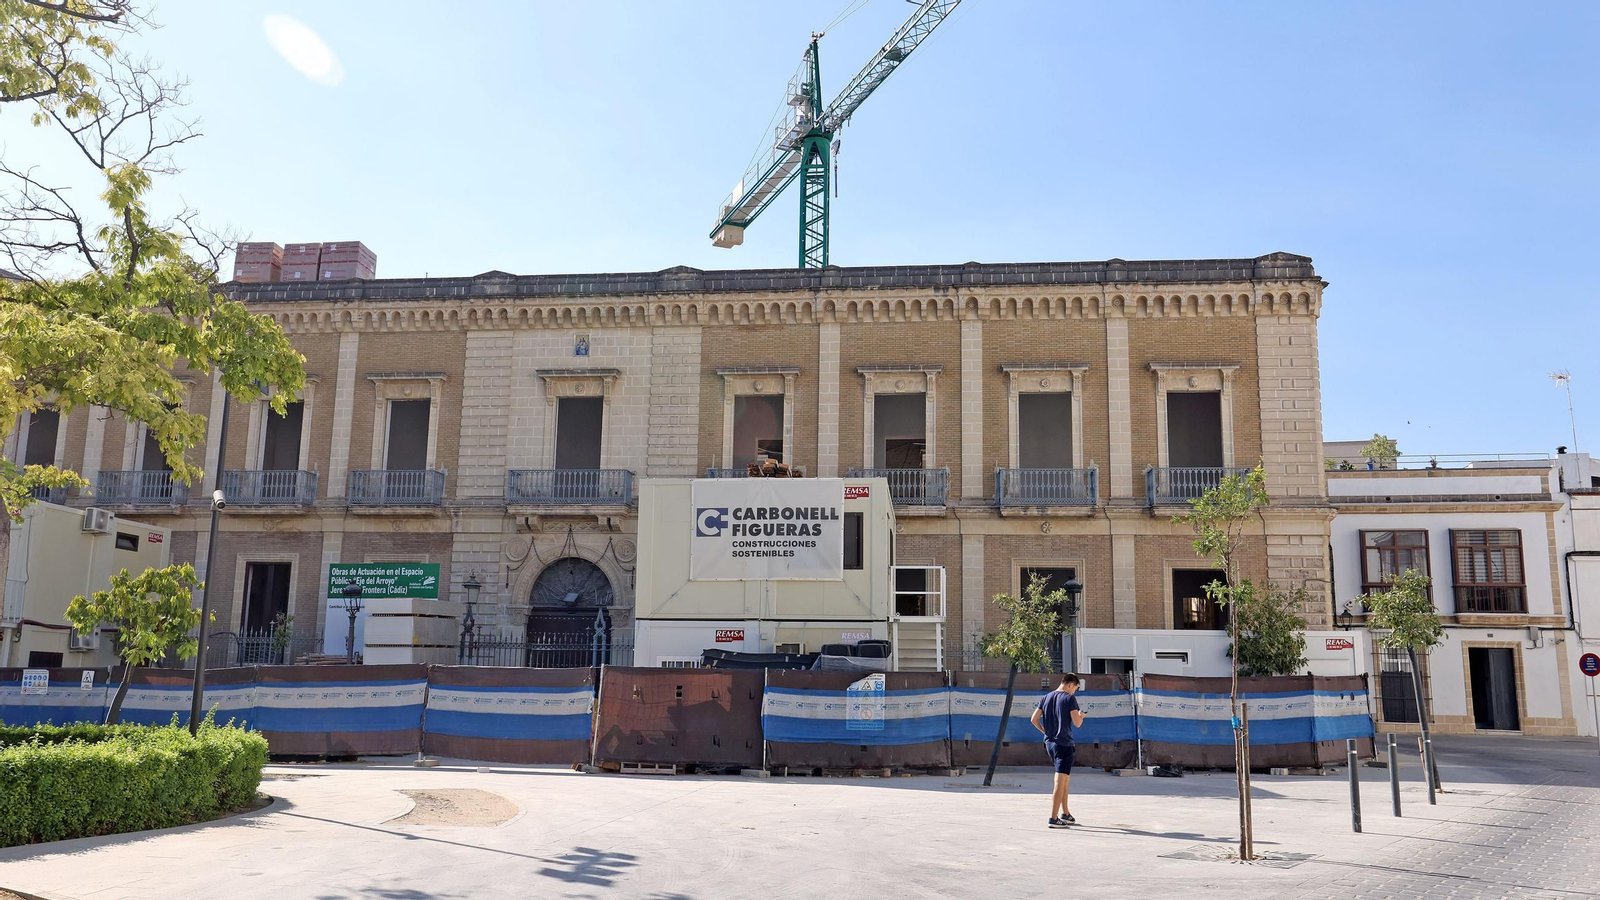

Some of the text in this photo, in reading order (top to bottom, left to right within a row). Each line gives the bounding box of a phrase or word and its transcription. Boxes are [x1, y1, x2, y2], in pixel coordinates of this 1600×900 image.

[732, 507, 839, 521] CARBONELL
[732, 523, 822, 537] FIGUERAS
[732, 540, 817, 548] CONSTRUCCIONES
[732, 550, 795, 558] SOSTENIBLES
[331, 567, 424, 577] Obras de Actuación en el Espacio
[366, 576, 375, 585] del
[361, 585, 387, 594] Frontera
[387, 585, 408, 595] (Cádiz)
[841, 632, 870, 640] REMSA
